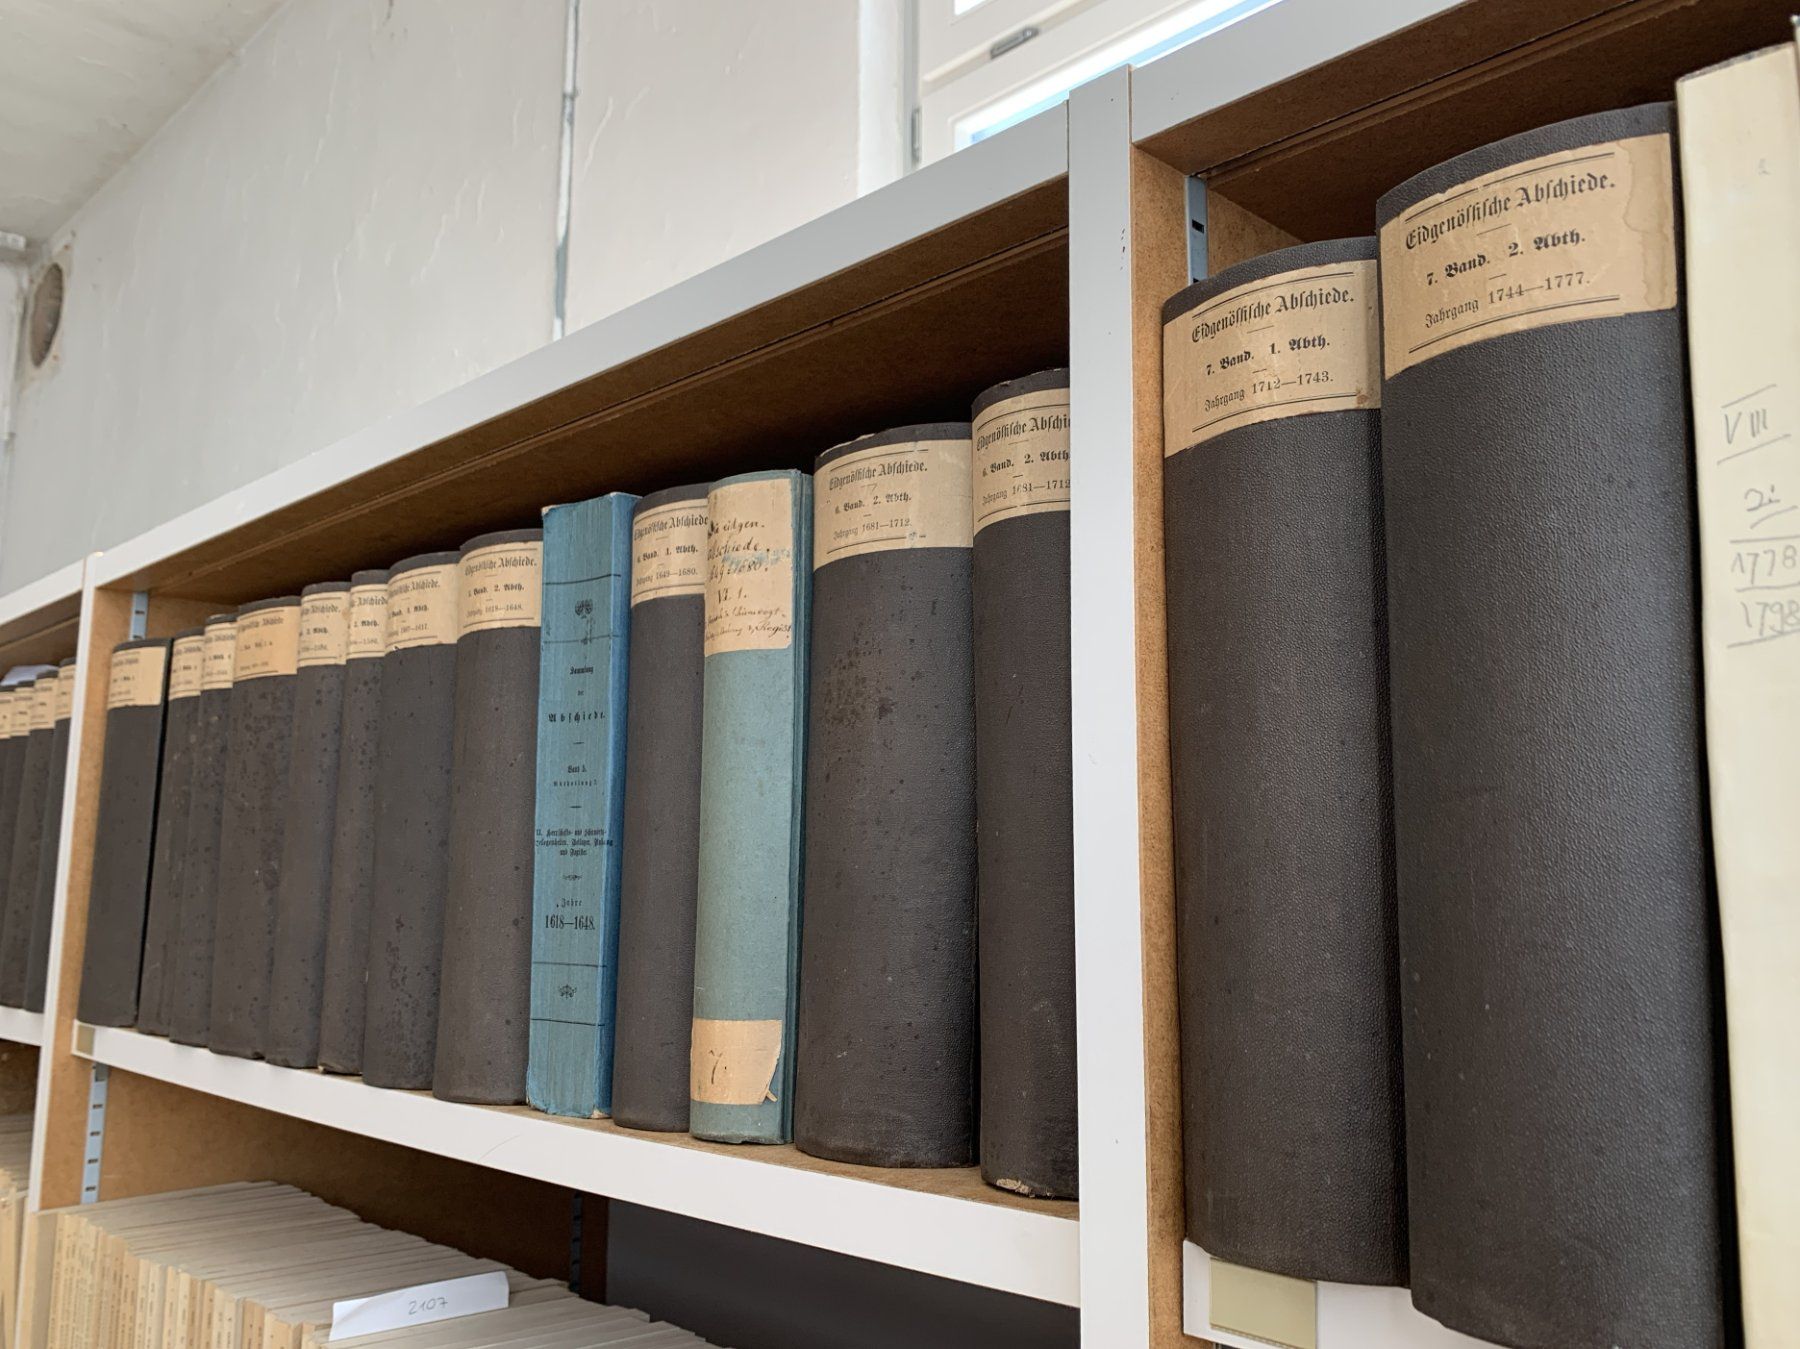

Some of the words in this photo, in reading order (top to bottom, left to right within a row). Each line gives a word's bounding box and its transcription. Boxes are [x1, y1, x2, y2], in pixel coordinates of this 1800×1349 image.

[1426, 272, 1438, 286] 7.
[1445, 253, 1490, 278] Band.
[1508, 242, 1523, 258] 2.
[1534, 229, 1585, 251] Abth.
[1425, 299, 1479, 328] Jahrgang
[1206, 364, 1215, 375] 7.
[1219, 351, 1254, 370] Band.
[1268, 343, 1281, 355] 1.
[1289, 335, 1330, 351] Abth.
[1204, 388, 1245, 412] Jahrgang
[1724, 409, 1768, 444] VIII
[990, 459, 1014, 473] Band.
[1024, 453, 1034, 464] 2.
[873, 496, 881, 505] 2.
[885, 492, 912, 503] Abth.
[408, 1297, 448, 1315] 2107
